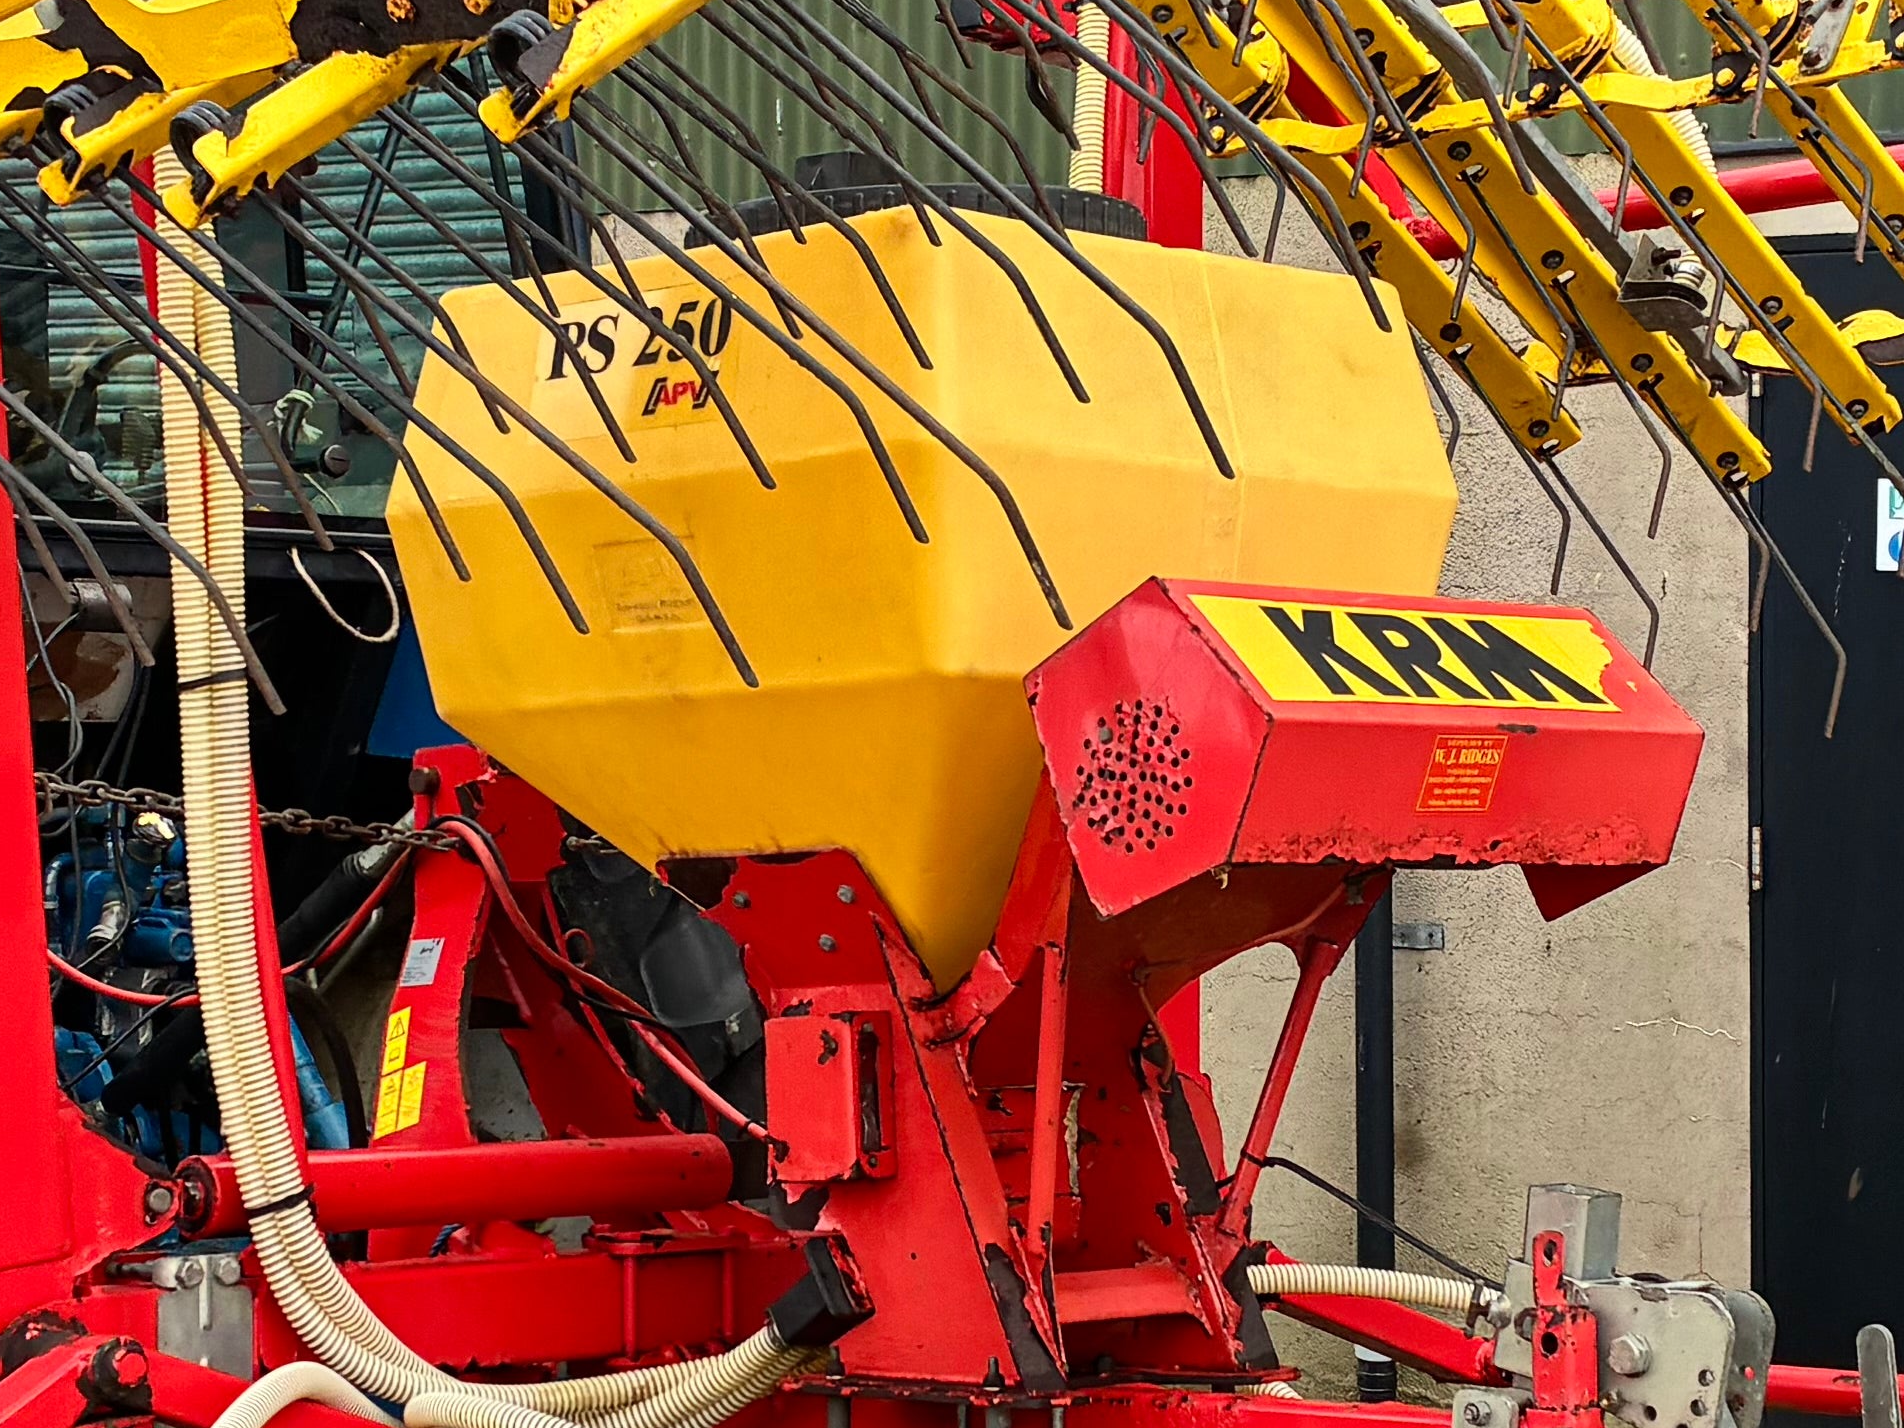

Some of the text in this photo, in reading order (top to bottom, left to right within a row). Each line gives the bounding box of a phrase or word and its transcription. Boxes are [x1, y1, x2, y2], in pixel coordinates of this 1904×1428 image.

[545, 298, 733, 381] PS 250
[1258, 605, 1608, 705] KRM
